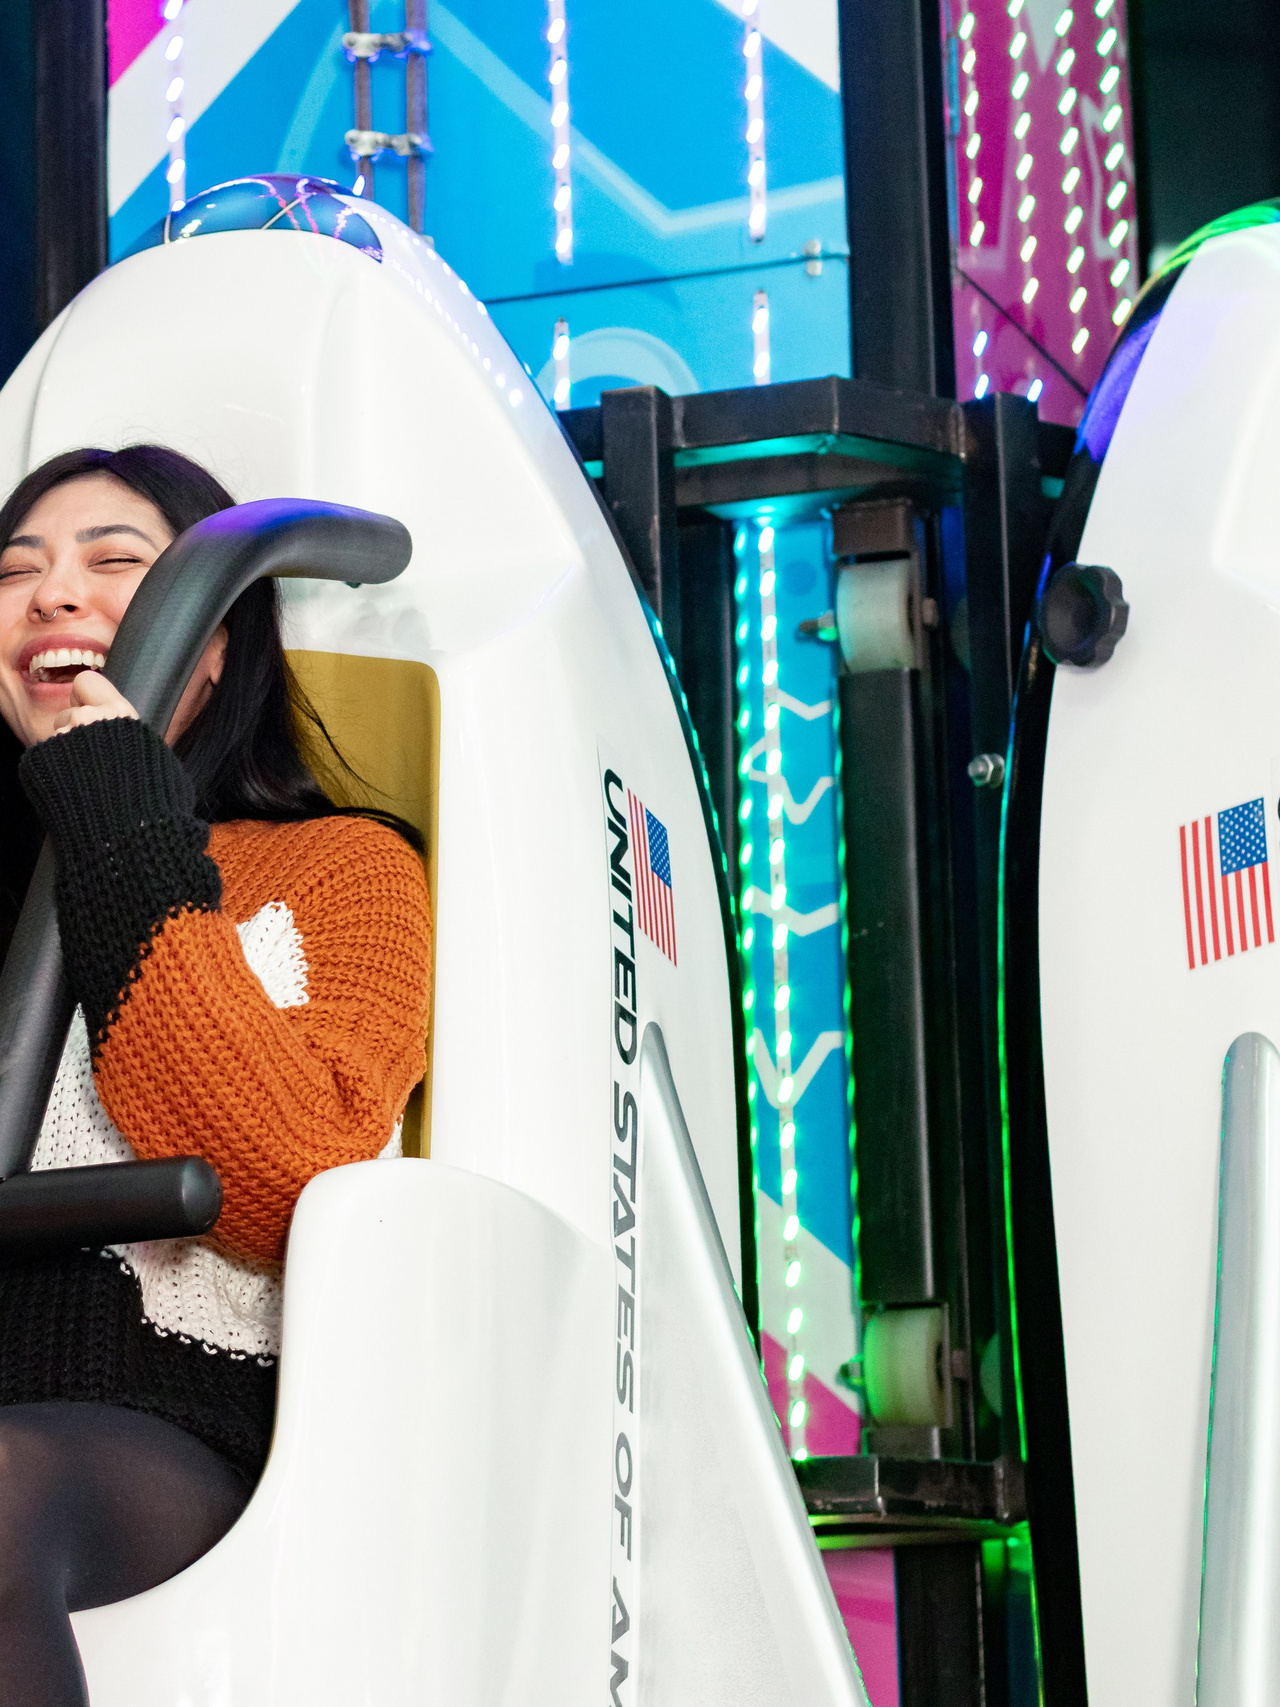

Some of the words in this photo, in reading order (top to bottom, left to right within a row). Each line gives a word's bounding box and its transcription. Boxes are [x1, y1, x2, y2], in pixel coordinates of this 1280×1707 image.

[603, 768, 638, 1066] UNITED
[612, 1080, 638, 1414] STATES
[614, 1431, 634, 1563] OF
